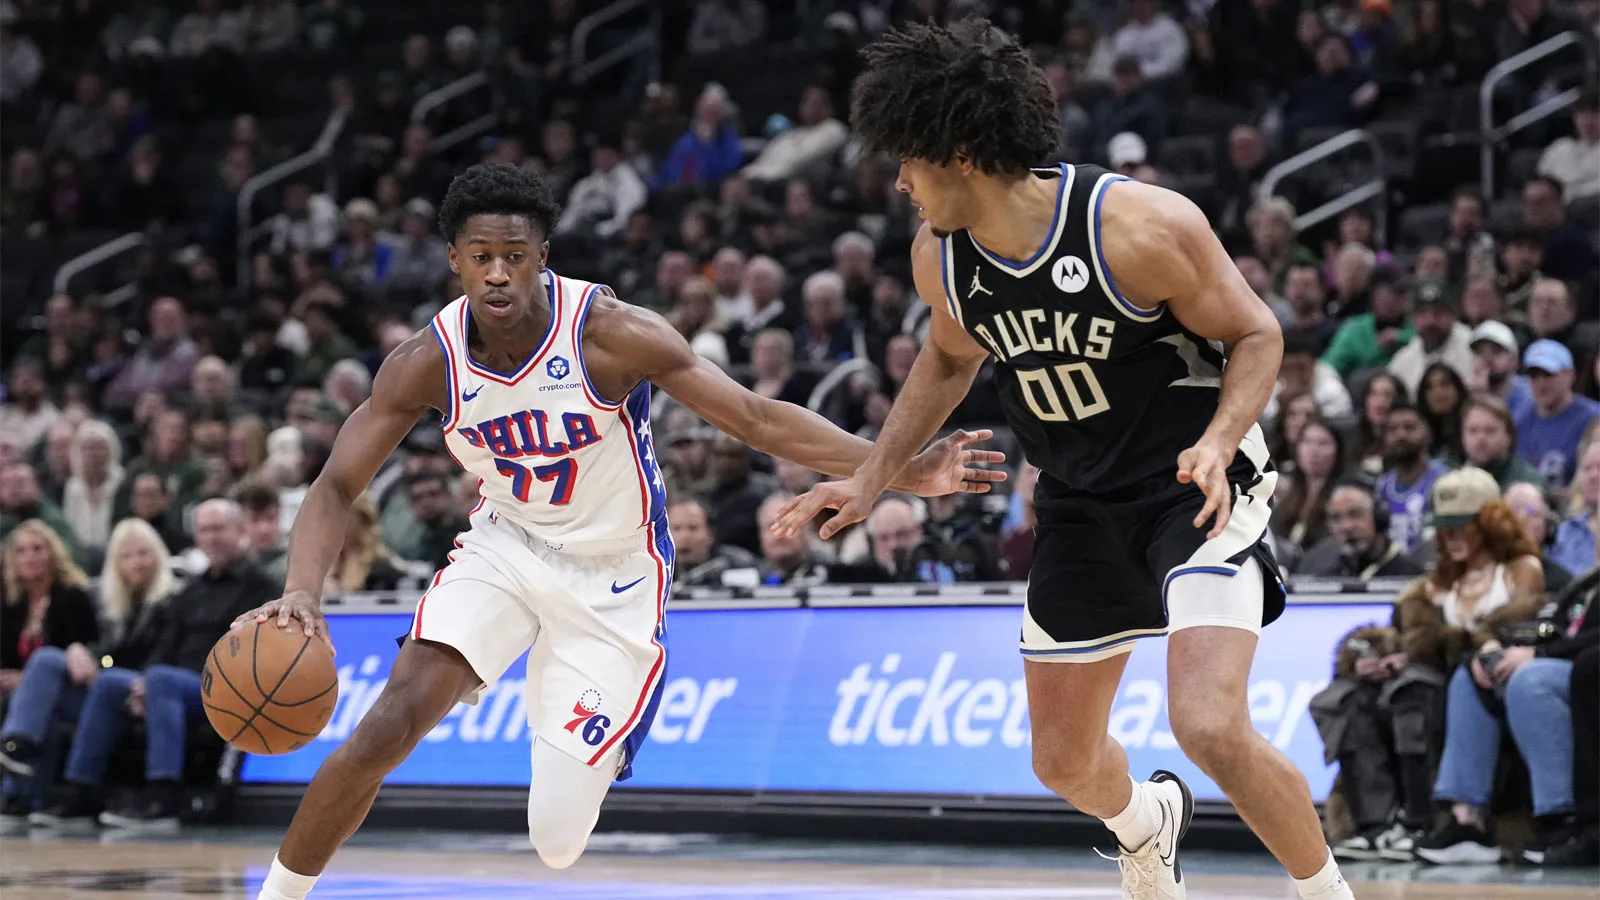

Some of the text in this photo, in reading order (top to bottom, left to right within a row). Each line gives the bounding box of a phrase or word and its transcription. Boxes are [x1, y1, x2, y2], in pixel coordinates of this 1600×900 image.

[974, 309, 1116, 362] BUCKS
[538, 382, 582, 392] crypto.com
[1016, 362, 1111, 421] 00
[457, 409, 602, 458] PHILA
[494, 457, 578, 506] 77
[563, 700, 611, 746] 76
